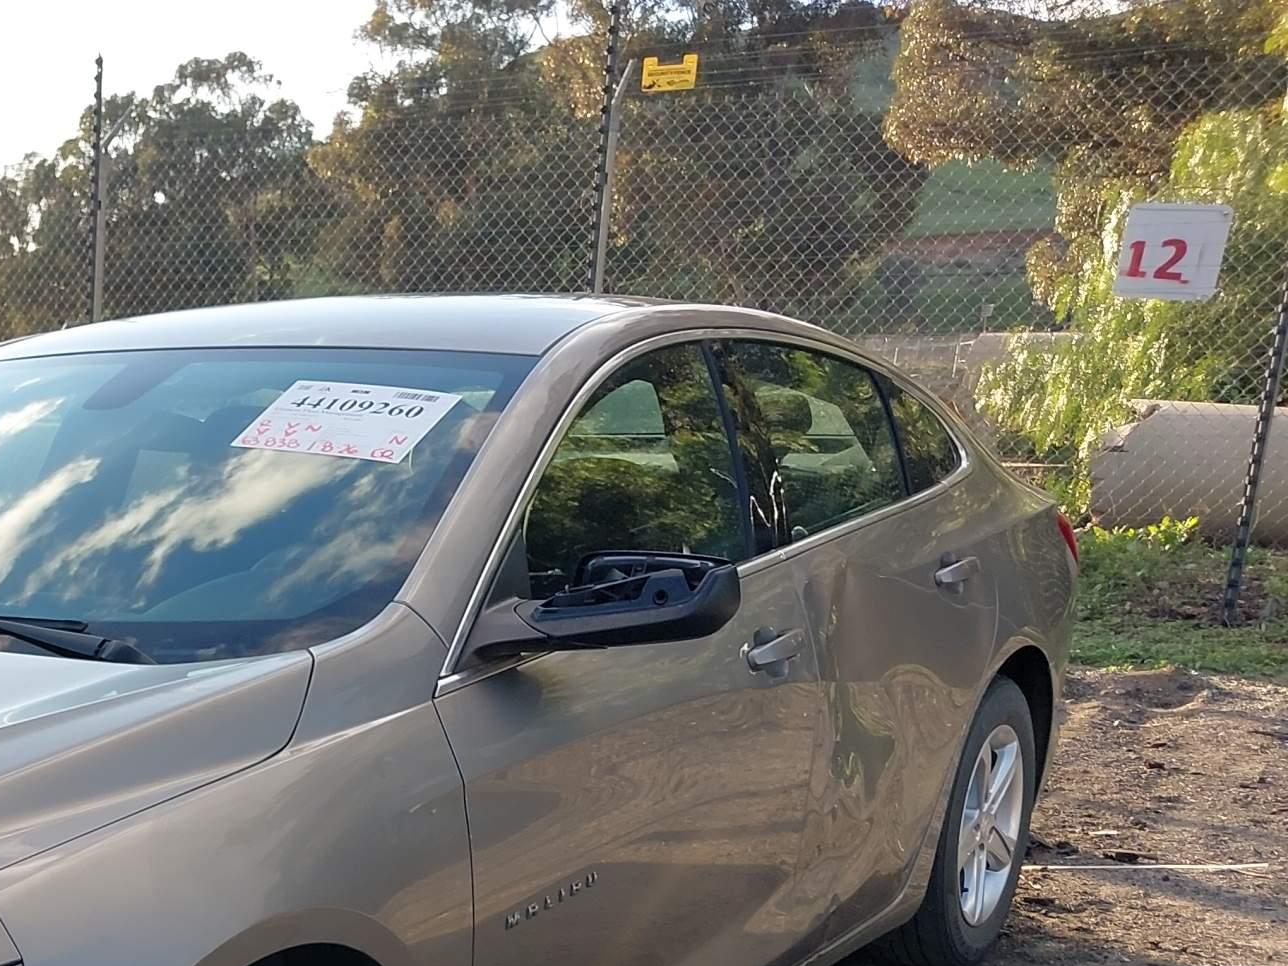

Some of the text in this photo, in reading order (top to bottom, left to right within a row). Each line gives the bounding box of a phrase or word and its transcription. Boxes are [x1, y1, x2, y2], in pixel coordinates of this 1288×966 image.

[1125, 238, 1187, 283] 12
[291, 396, 424, 419] 44109260
[504, 871, 599, 931] MALIBU
